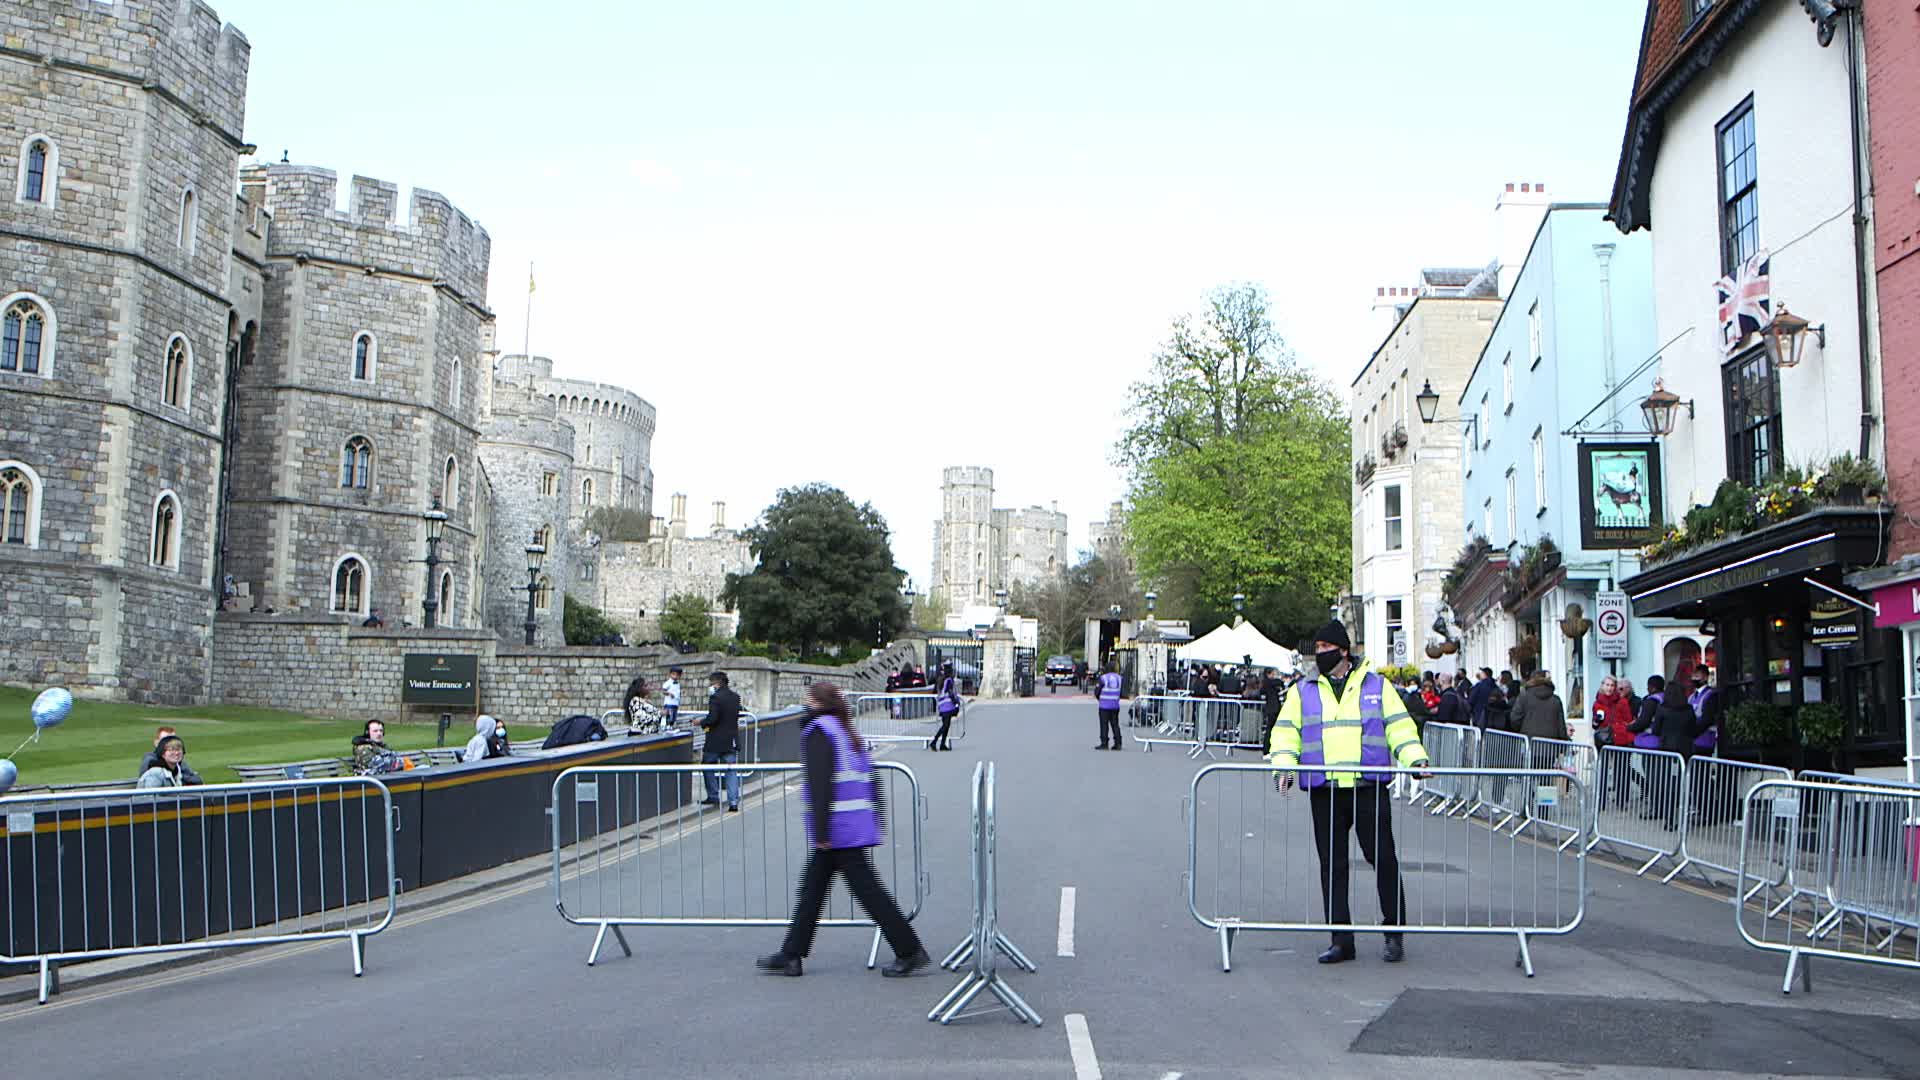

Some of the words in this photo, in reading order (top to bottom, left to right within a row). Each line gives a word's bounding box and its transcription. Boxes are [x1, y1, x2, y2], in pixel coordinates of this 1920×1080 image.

[1813, 627, 1826, 635] Ice
[1827, 625, 1856, 634] Cream
[409, 679, 431, 689] Visitor
[432, 680, 463, 689] Entrance
